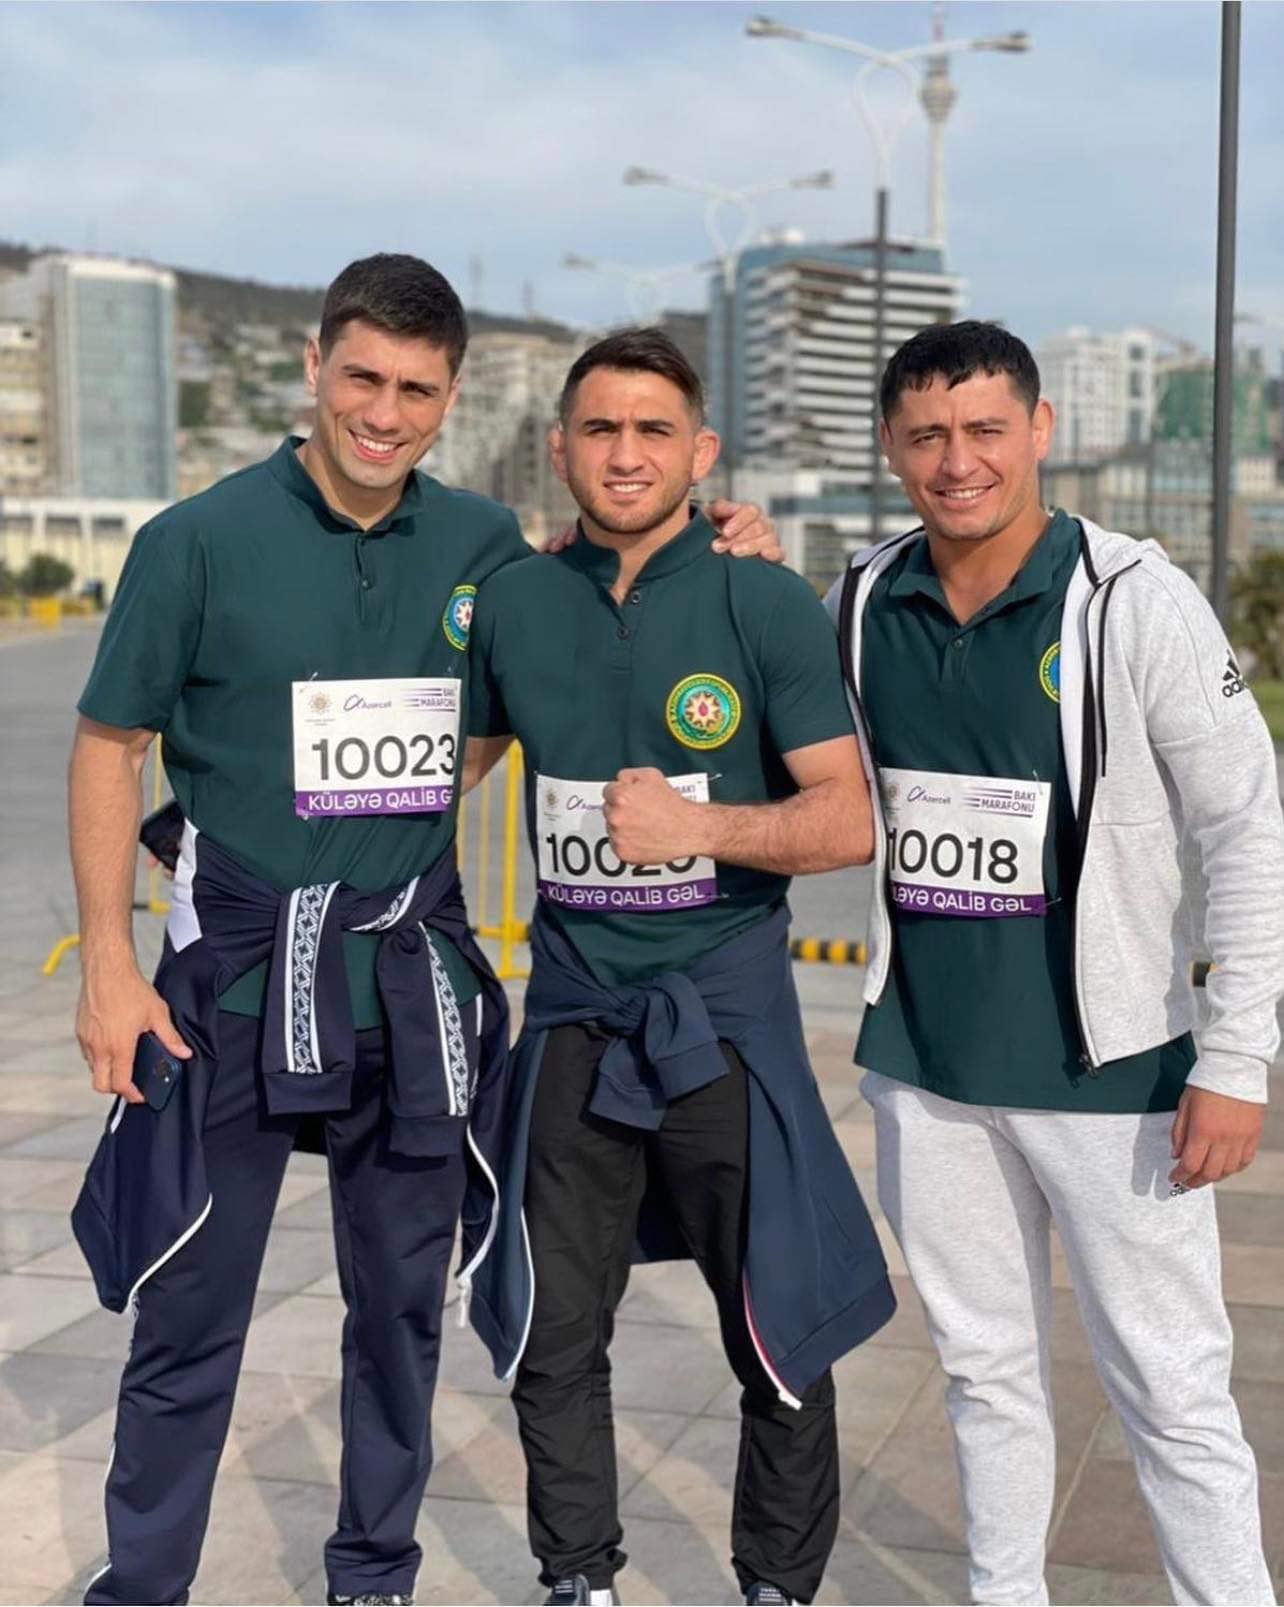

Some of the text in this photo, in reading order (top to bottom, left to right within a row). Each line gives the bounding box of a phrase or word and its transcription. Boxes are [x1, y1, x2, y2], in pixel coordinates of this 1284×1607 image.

[312, 733, 456, 781] 10023
[308, 791, 382, 810] KÜLƏYƏ
[386, 788, 437, 808] QALİB
[981, 798, 1035, 813] MARAFONU
[887, 828, 1018, 884] 10018
[548, 884, 705, 907] KÜLƏYƏ QALİB GƏL
[933, 891, 986, 911] QALİB
[990, 897, 1032, 913] GƏL
